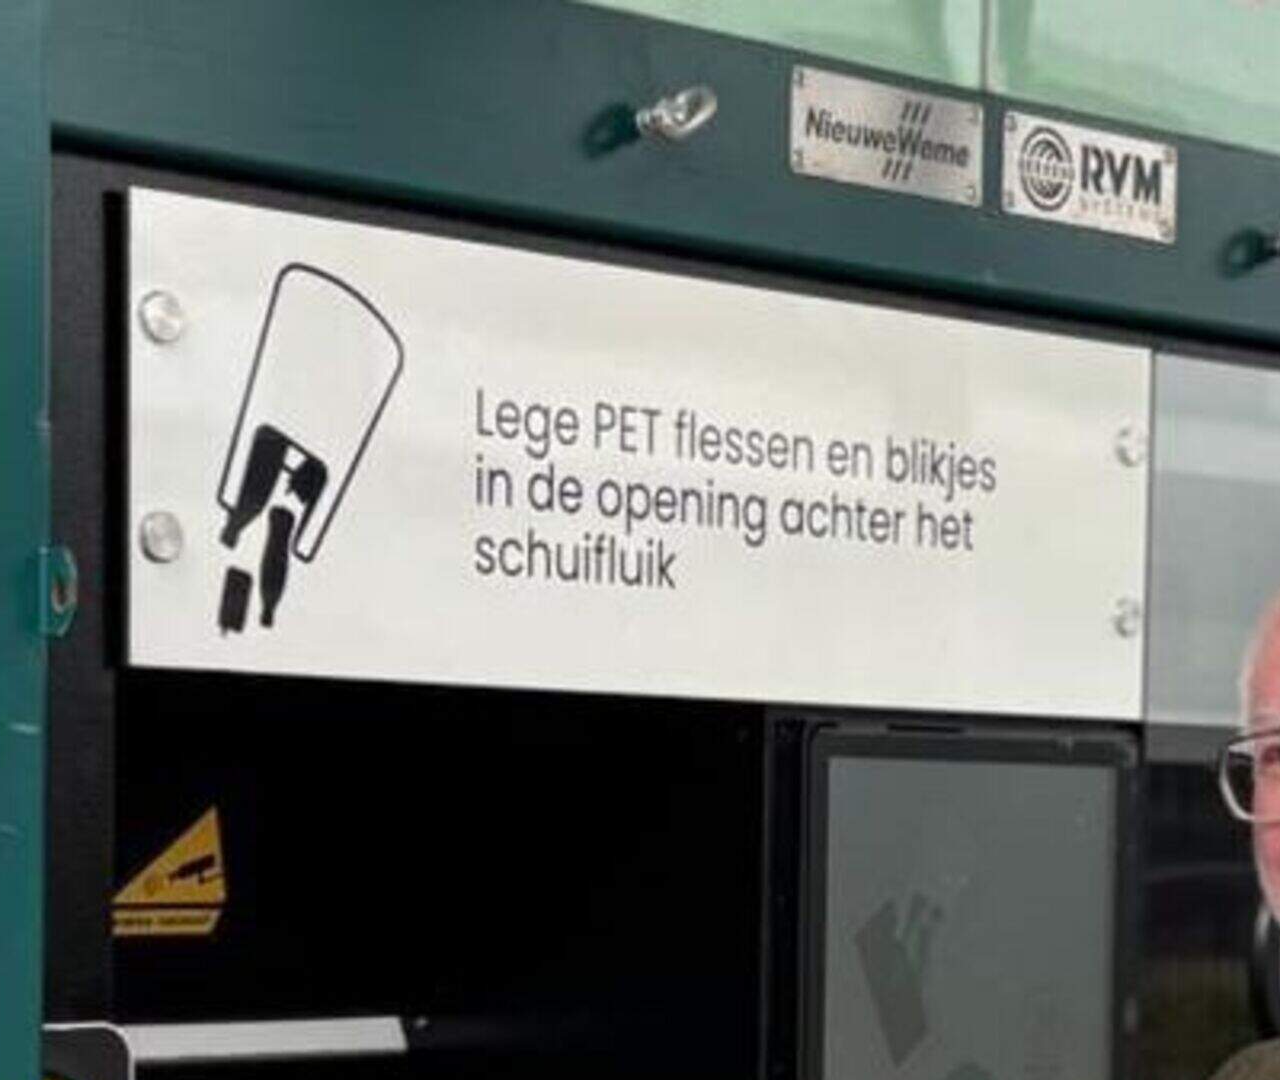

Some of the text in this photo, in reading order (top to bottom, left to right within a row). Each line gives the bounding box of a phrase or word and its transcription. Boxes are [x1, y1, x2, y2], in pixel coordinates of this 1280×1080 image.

[805, 107, 972, 168] NieuweWeme
[1081, 143, 1162, 206] RVM
[476, 387, 997, 501] Lege PET flessen en blikjes
[475, 453, 974, 551] in de opening achter het
[475, 527, 677, 589] schuifluik
